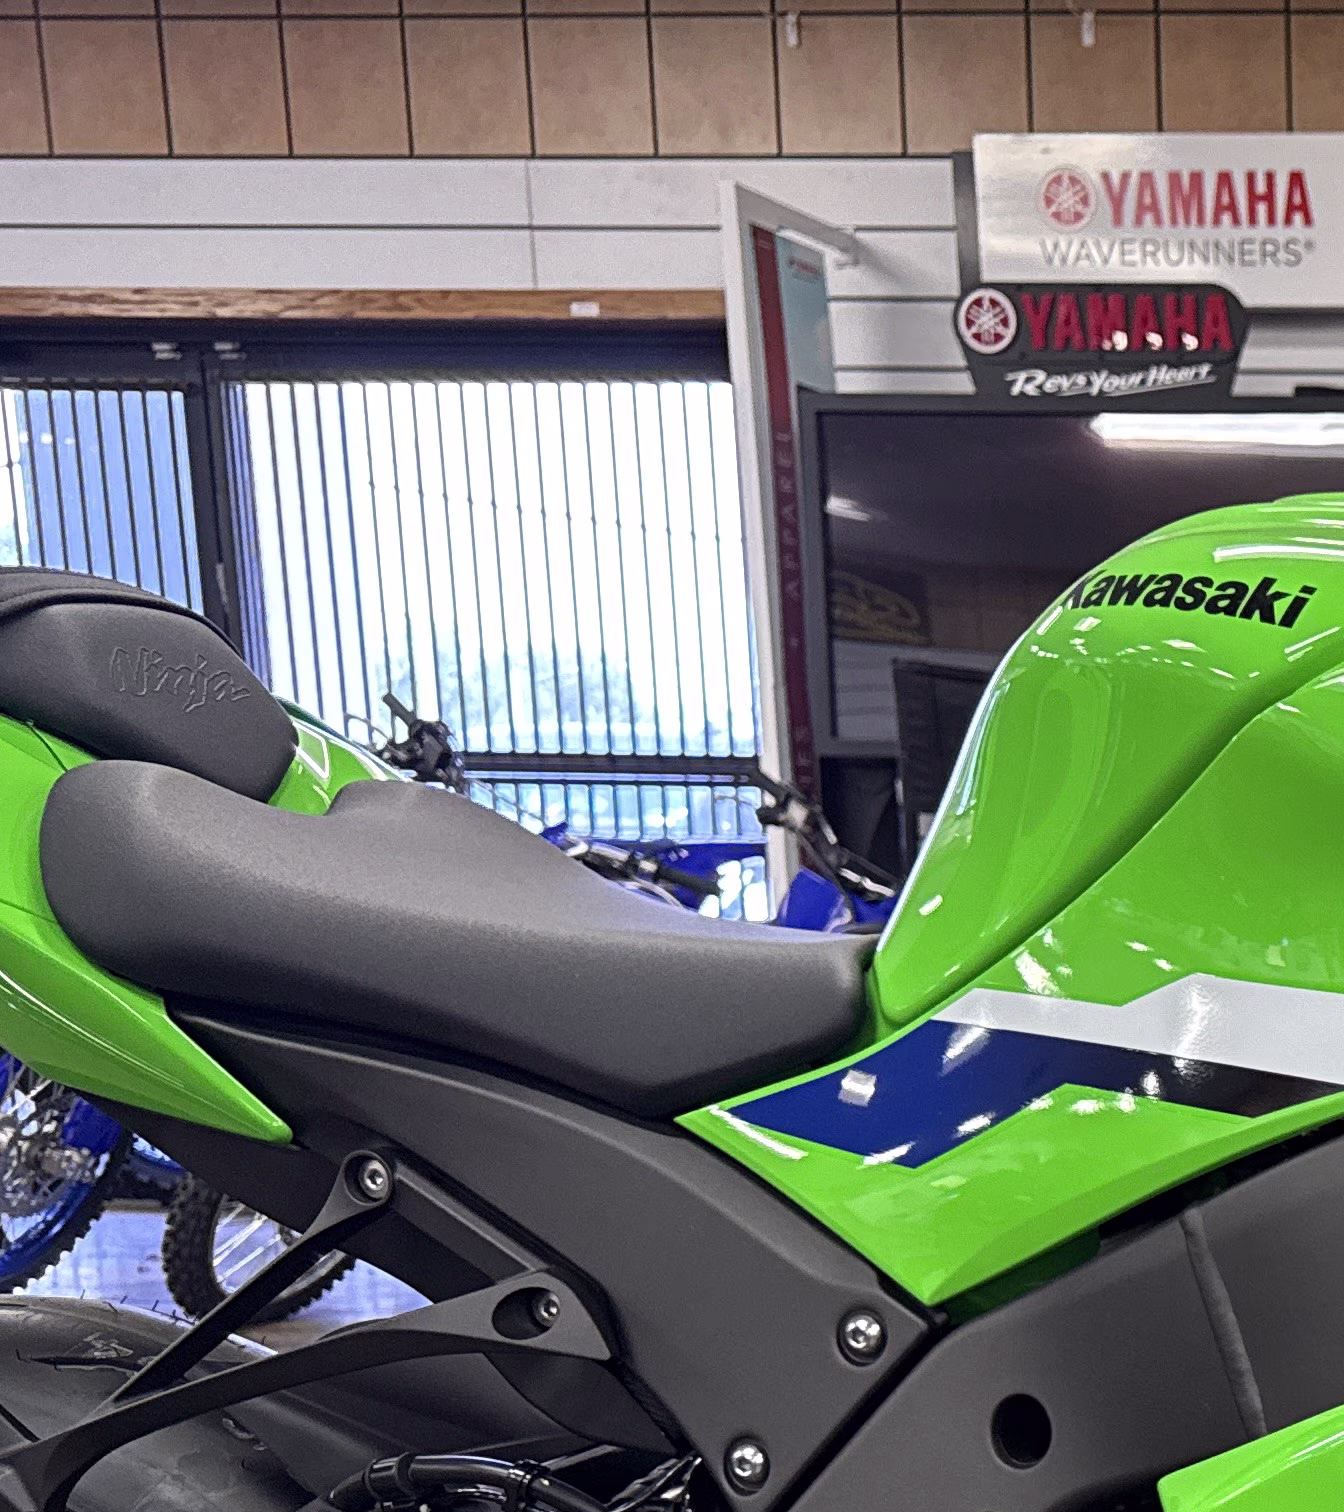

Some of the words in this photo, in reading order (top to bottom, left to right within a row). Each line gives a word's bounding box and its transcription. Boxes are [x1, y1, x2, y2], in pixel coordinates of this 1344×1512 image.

[1101, 168, 1316, 229] YAMAHA
[1020, 293, 1235, 352] YAMAHA
[1088, 369, 1146, 397] Your
[1145, 362, 1214, 387] Heart
[109, 646, 251, 713] Ninja
